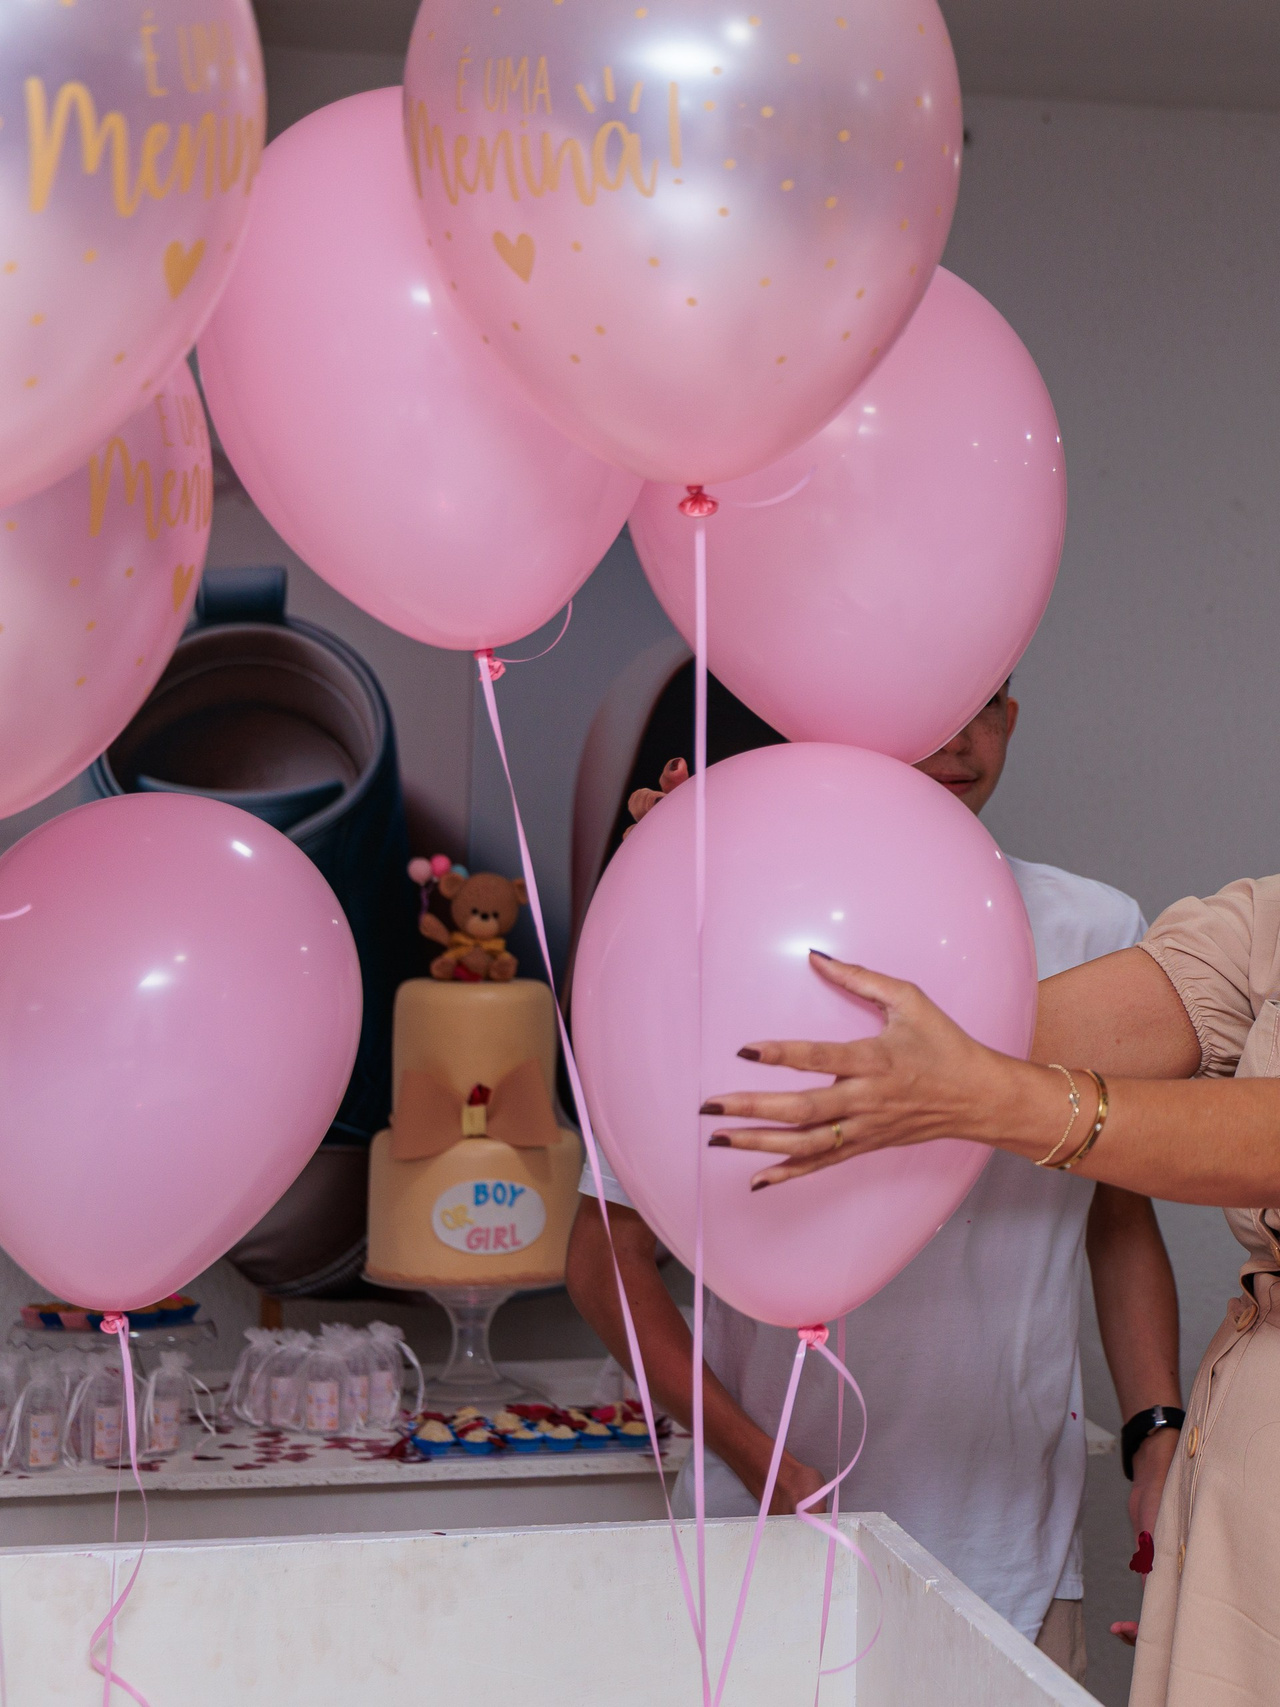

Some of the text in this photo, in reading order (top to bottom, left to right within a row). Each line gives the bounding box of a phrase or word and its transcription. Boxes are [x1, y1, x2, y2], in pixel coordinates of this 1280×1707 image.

[456, 46, 552, 116] É UMA
[409, 81, 685, 207] Menina!
[473, 1181, 526, 1207] BOY
[440, 1204, 474, 1230] OR
[466, 1223, 522, 1251] GIRL
